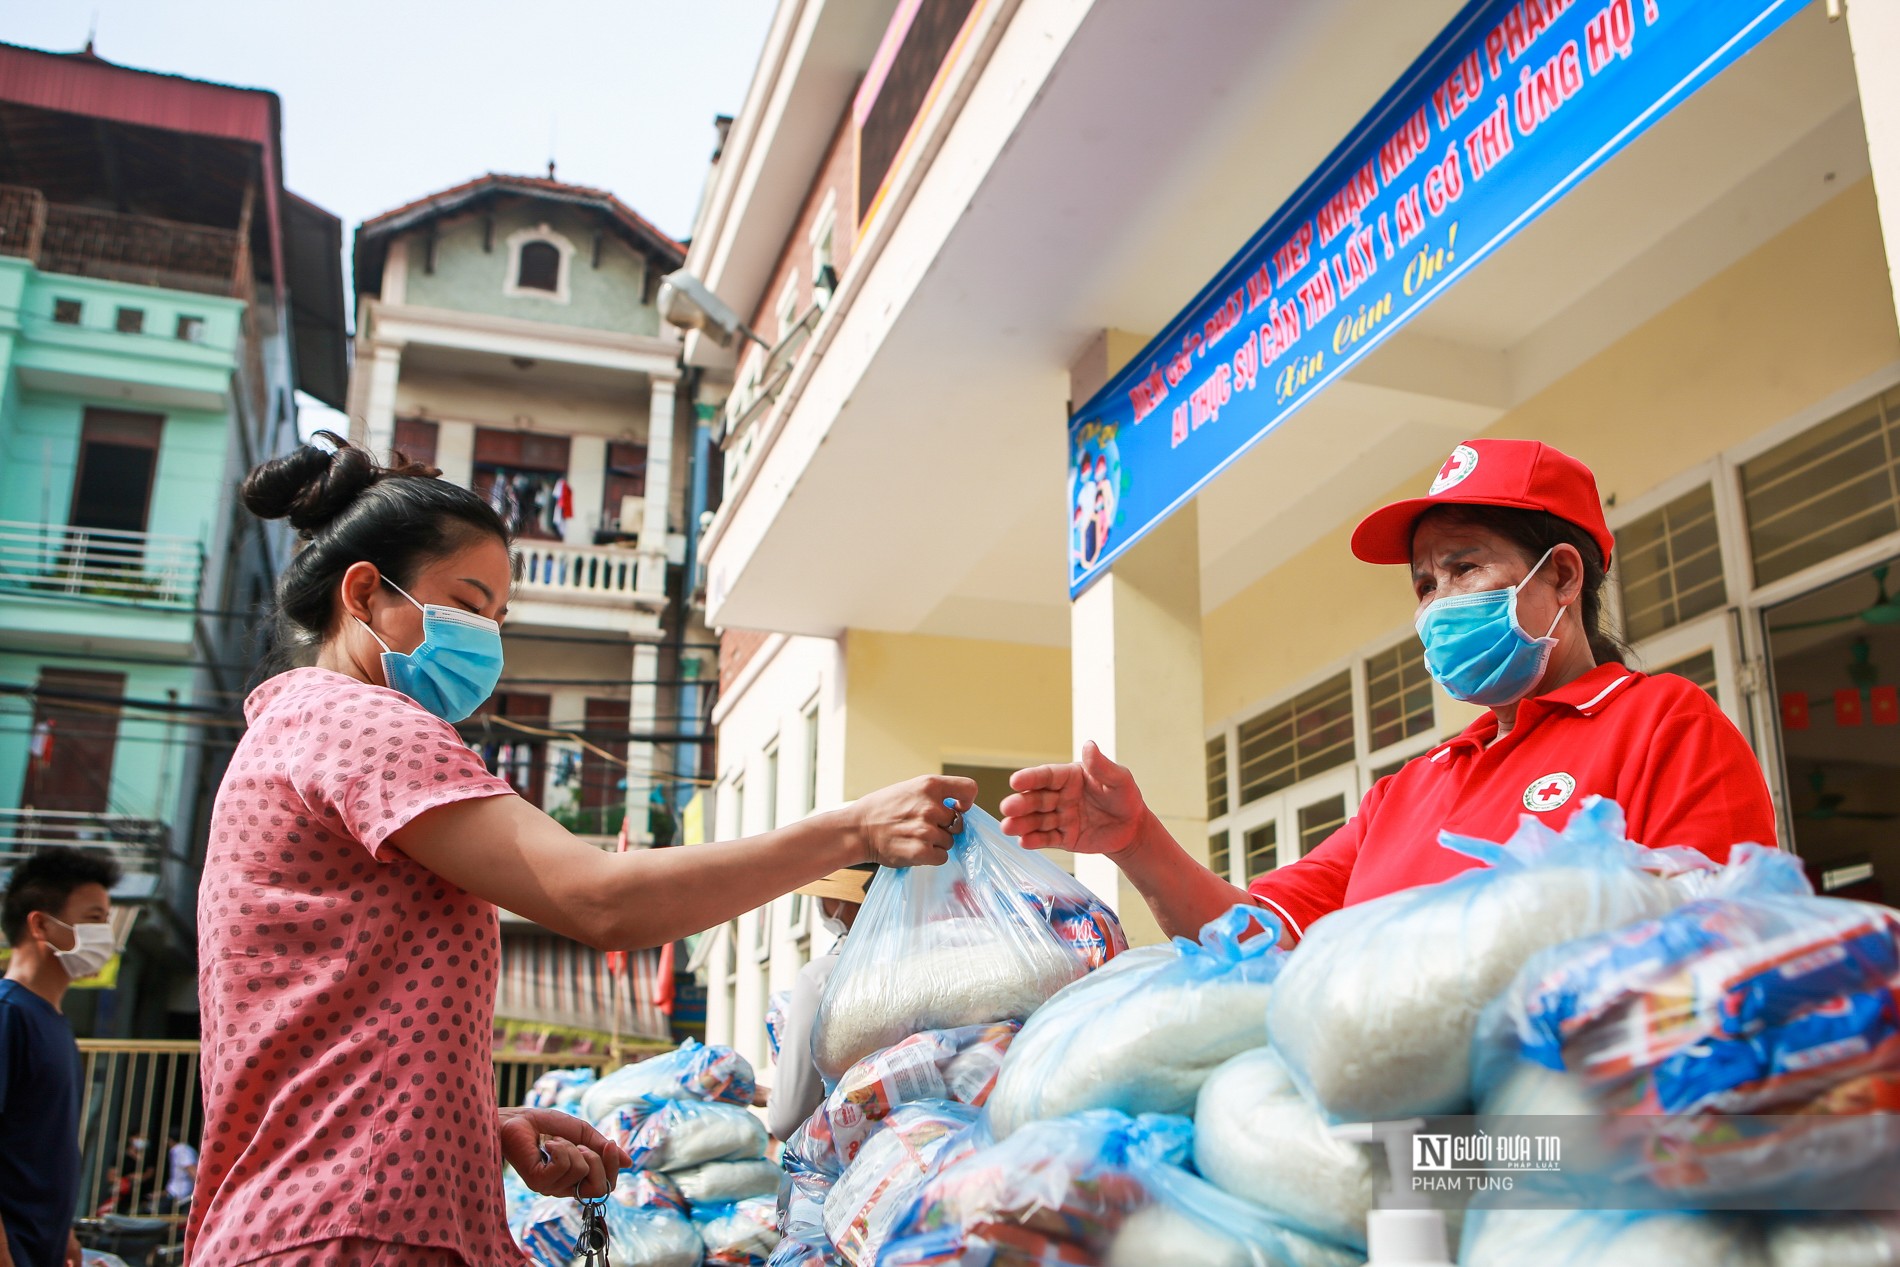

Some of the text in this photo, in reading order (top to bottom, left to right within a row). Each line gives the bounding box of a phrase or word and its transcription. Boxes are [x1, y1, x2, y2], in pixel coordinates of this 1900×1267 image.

[1378, 104, 1430, 187] NHU
[1171, 400, 1189, 449] AI
[1233, 330, 1258, 392] SỰ
[1259, 297, 1300, 368] CẦN
[1297, 258, 1336, 332] THÌ
[1332, 221, 1377, 301] LẤY
[1395, 183, 1425, 249] AI
[1424, 140, 1464, 217] CÓ
[1464, 94, 1514, 182] THÌ
[1275, 220, 1459, 406] Xin Cảm Ơn!
